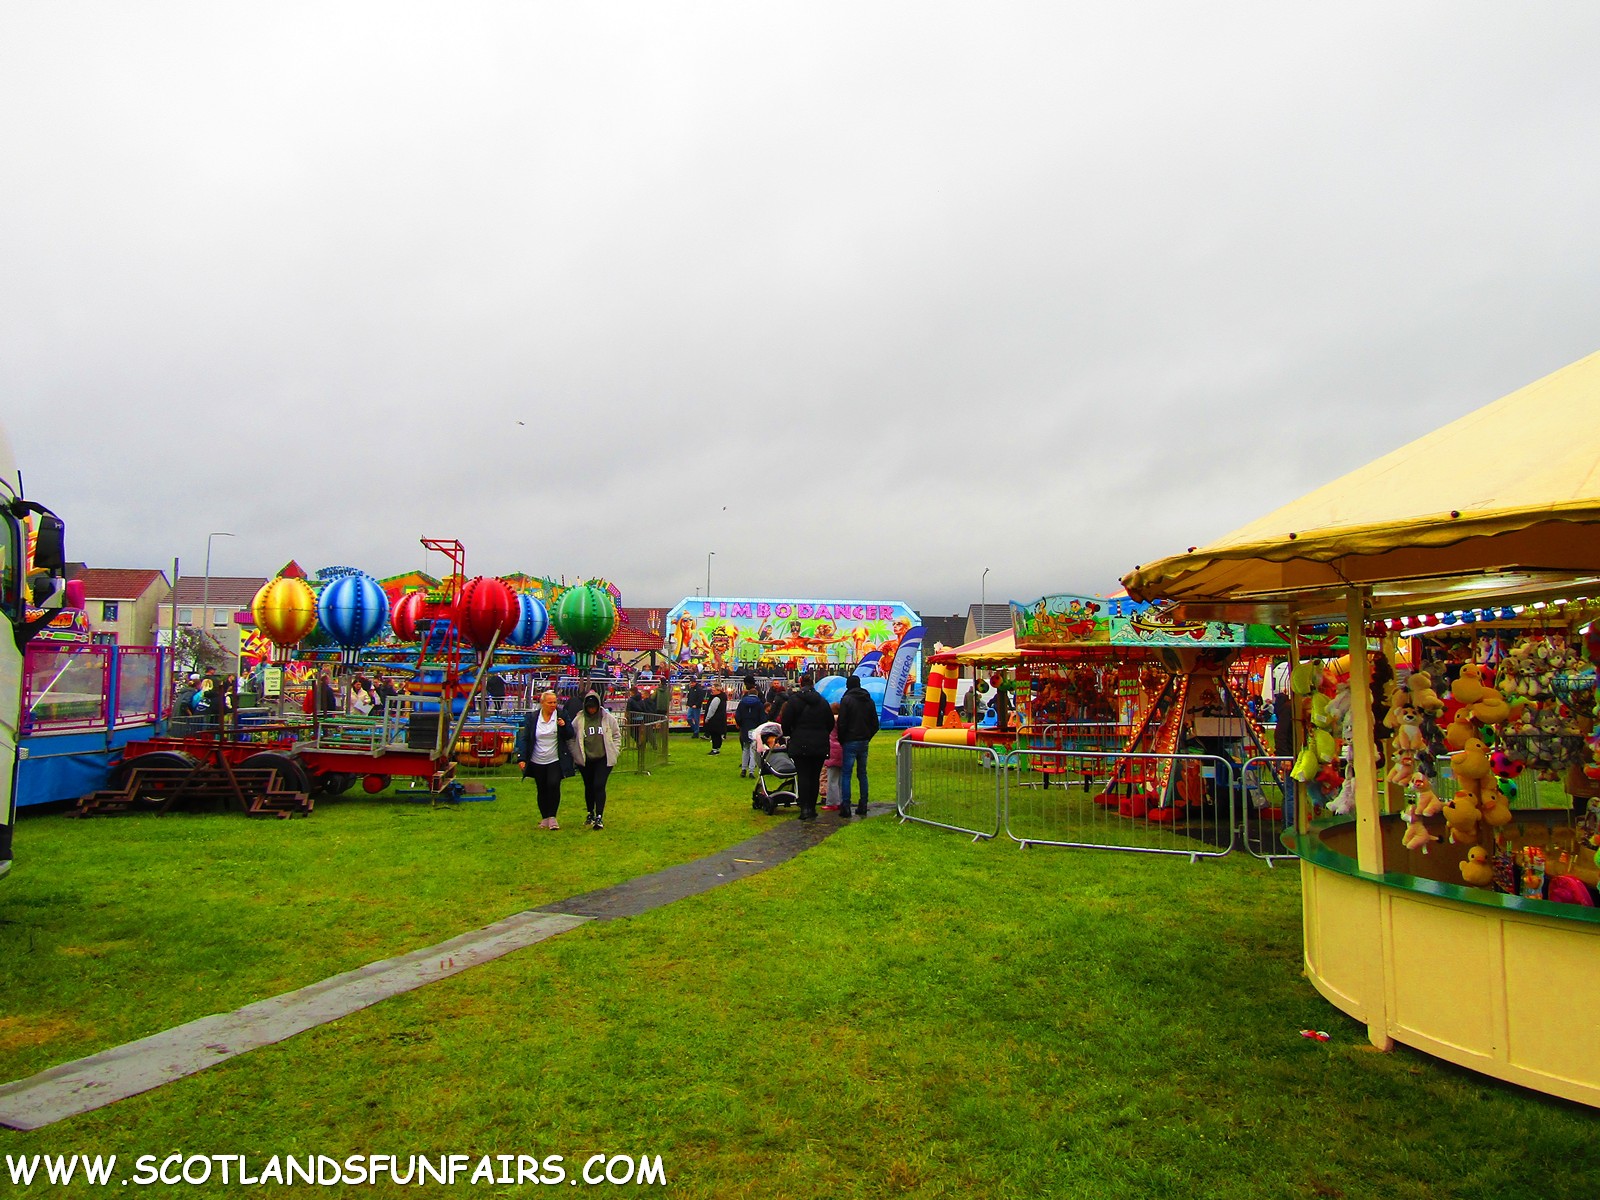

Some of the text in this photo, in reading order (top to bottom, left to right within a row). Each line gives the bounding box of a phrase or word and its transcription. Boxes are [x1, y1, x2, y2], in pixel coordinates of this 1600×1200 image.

[703, 601, 895, 621] LIMBO DANCER
[896, 654, 913, 697] WALKERS
